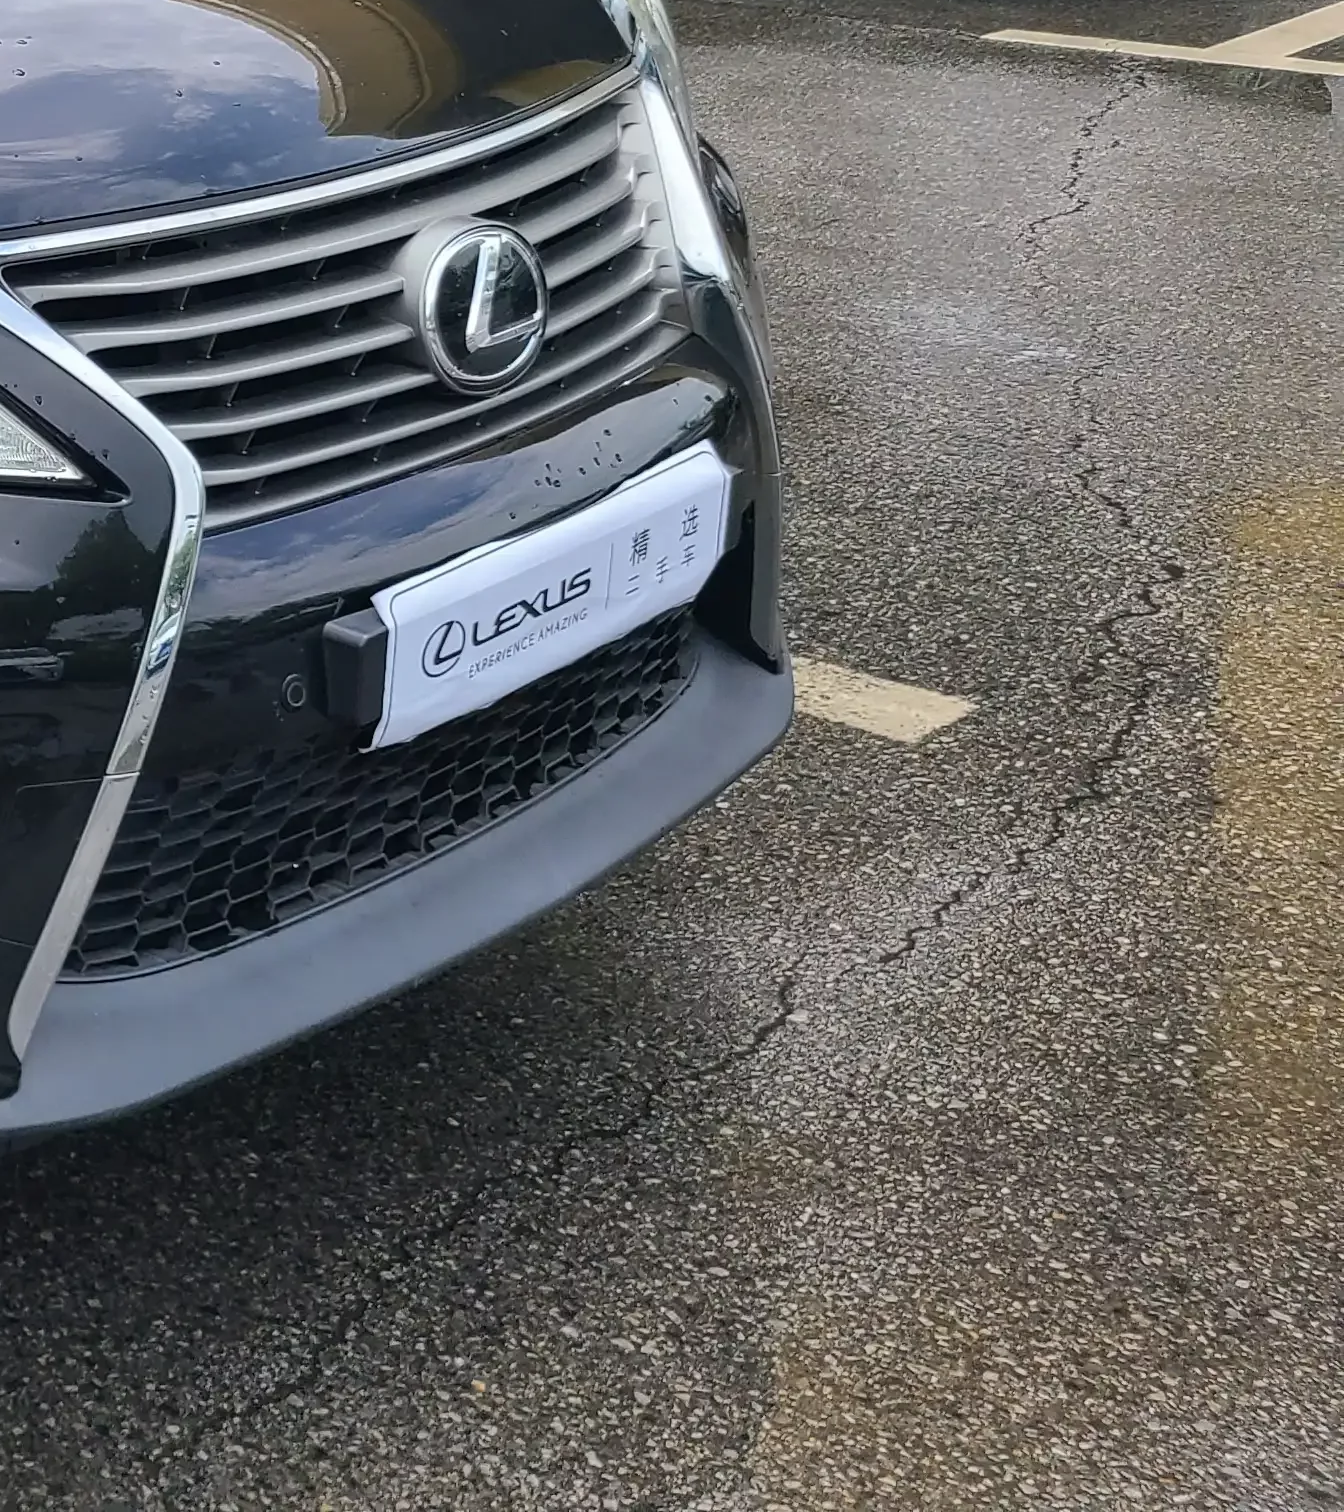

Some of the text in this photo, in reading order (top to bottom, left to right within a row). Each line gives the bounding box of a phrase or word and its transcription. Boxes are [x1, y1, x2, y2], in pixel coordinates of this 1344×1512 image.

[629, 503, 699, 567] 精选
[625, 543, 696, 596] 二手车
[472, 568, 591, 647] LEXUS
[468, 607, 588, 679] EXPERIENCE AMAZING
